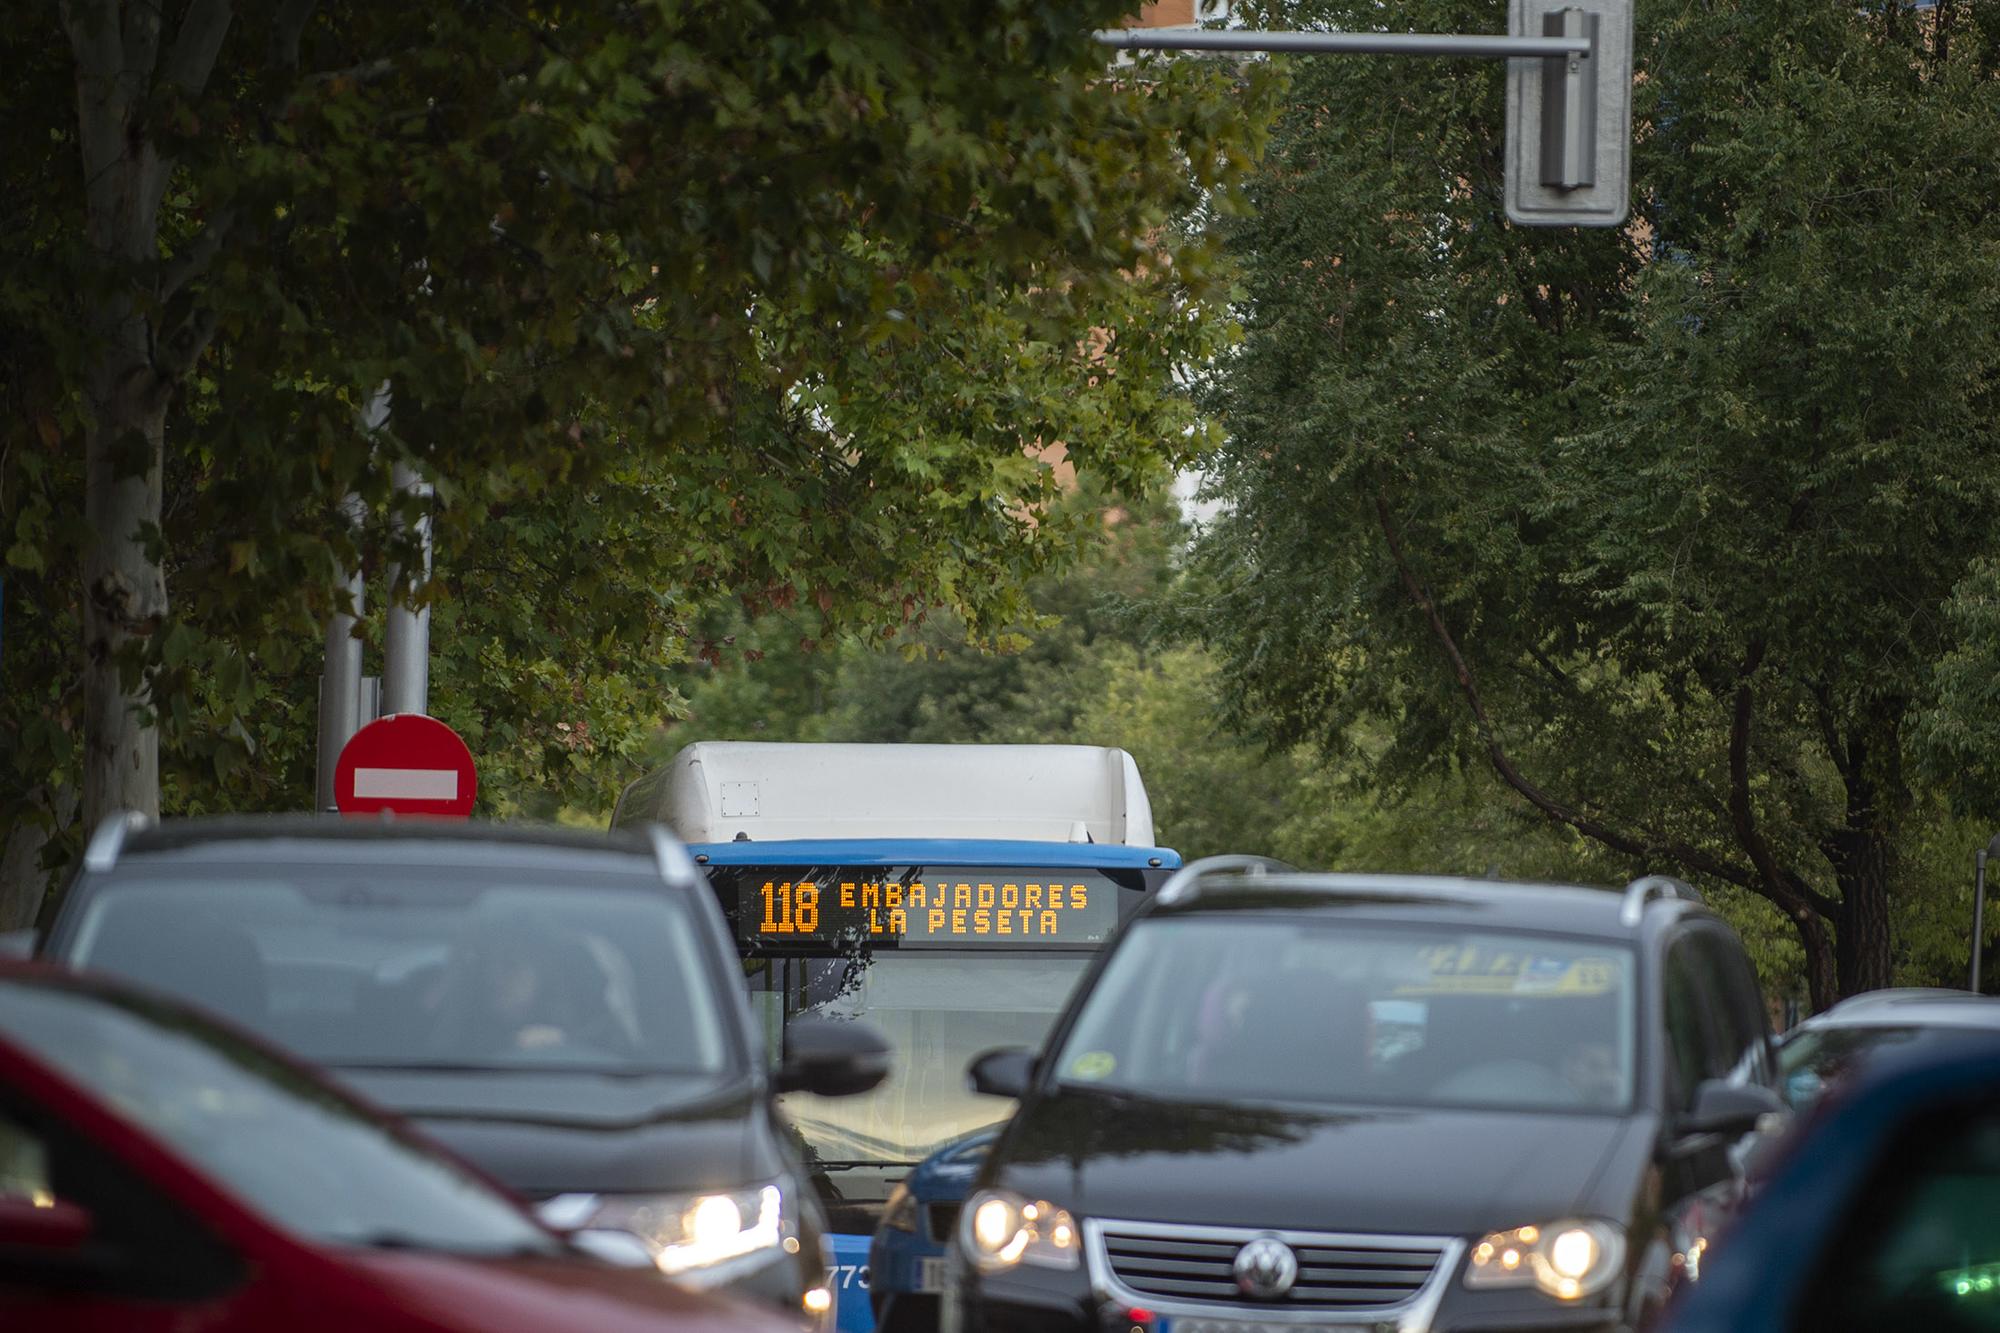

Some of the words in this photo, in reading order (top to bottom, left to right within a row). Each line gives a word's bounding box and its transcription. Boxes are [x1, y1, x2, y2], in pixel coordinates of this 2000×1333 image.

[761, 882, 819, 932] 118
[840, 882, 1088, 909] EMBAJADORES
[870, 908, 907, 933] LA
[928, 909, 1057, 934] PESETA
